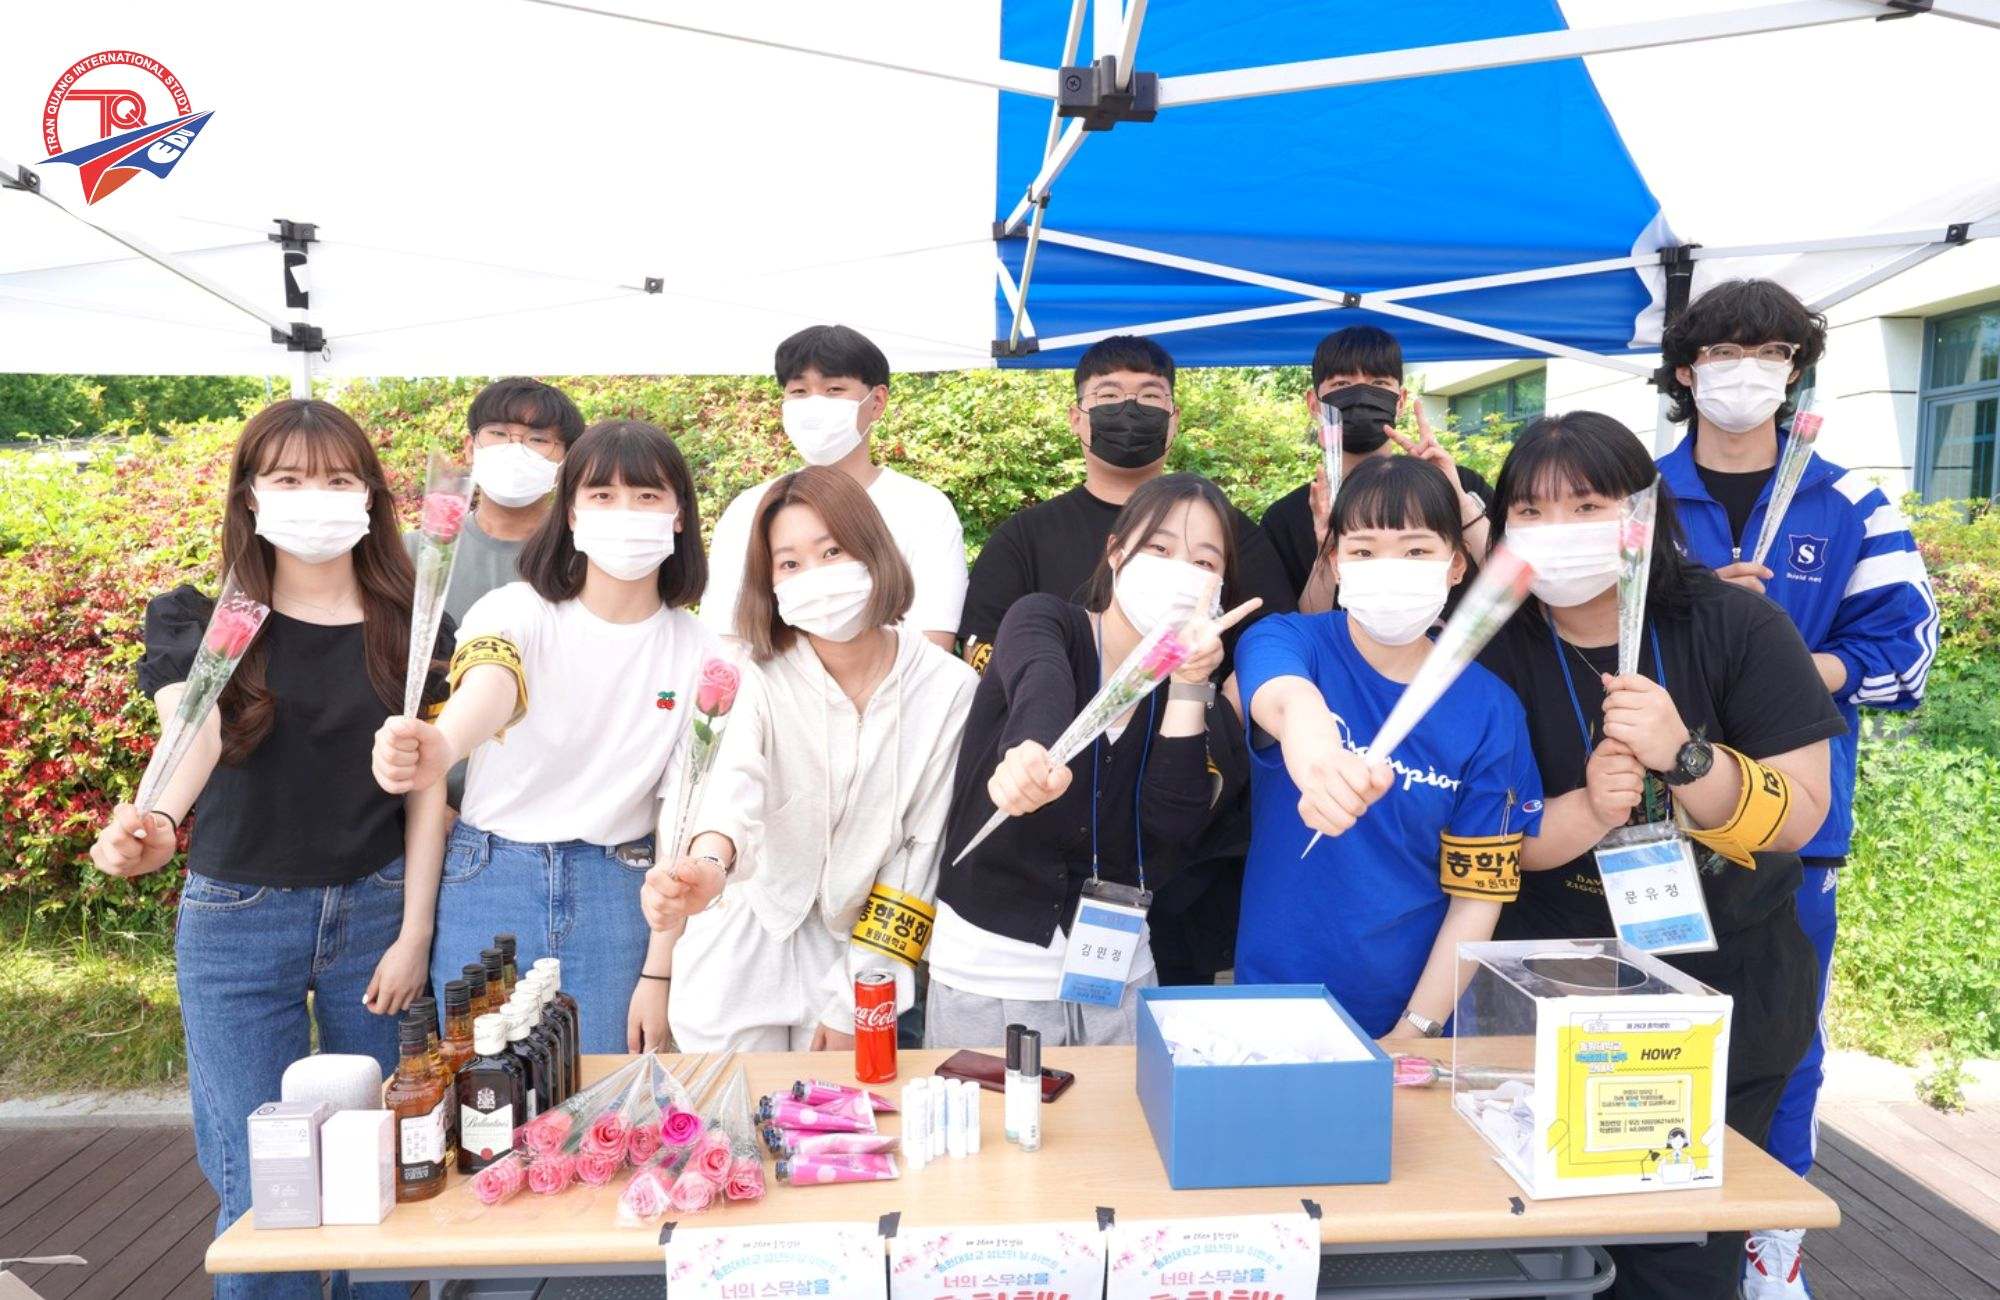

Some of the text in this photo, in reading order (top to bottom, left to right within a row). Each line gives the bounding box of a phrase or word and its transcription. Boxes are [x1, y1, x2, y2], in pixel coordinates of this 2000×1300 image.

[1798, 544, 1815, 564] S
[1640, 1047, 1682, 1061] HOW?
[943, 1274, 977, 1288] 너의
[1160, 1271, 1194, 1286] 너의
[720, 1282, 755, 1299] 너의
